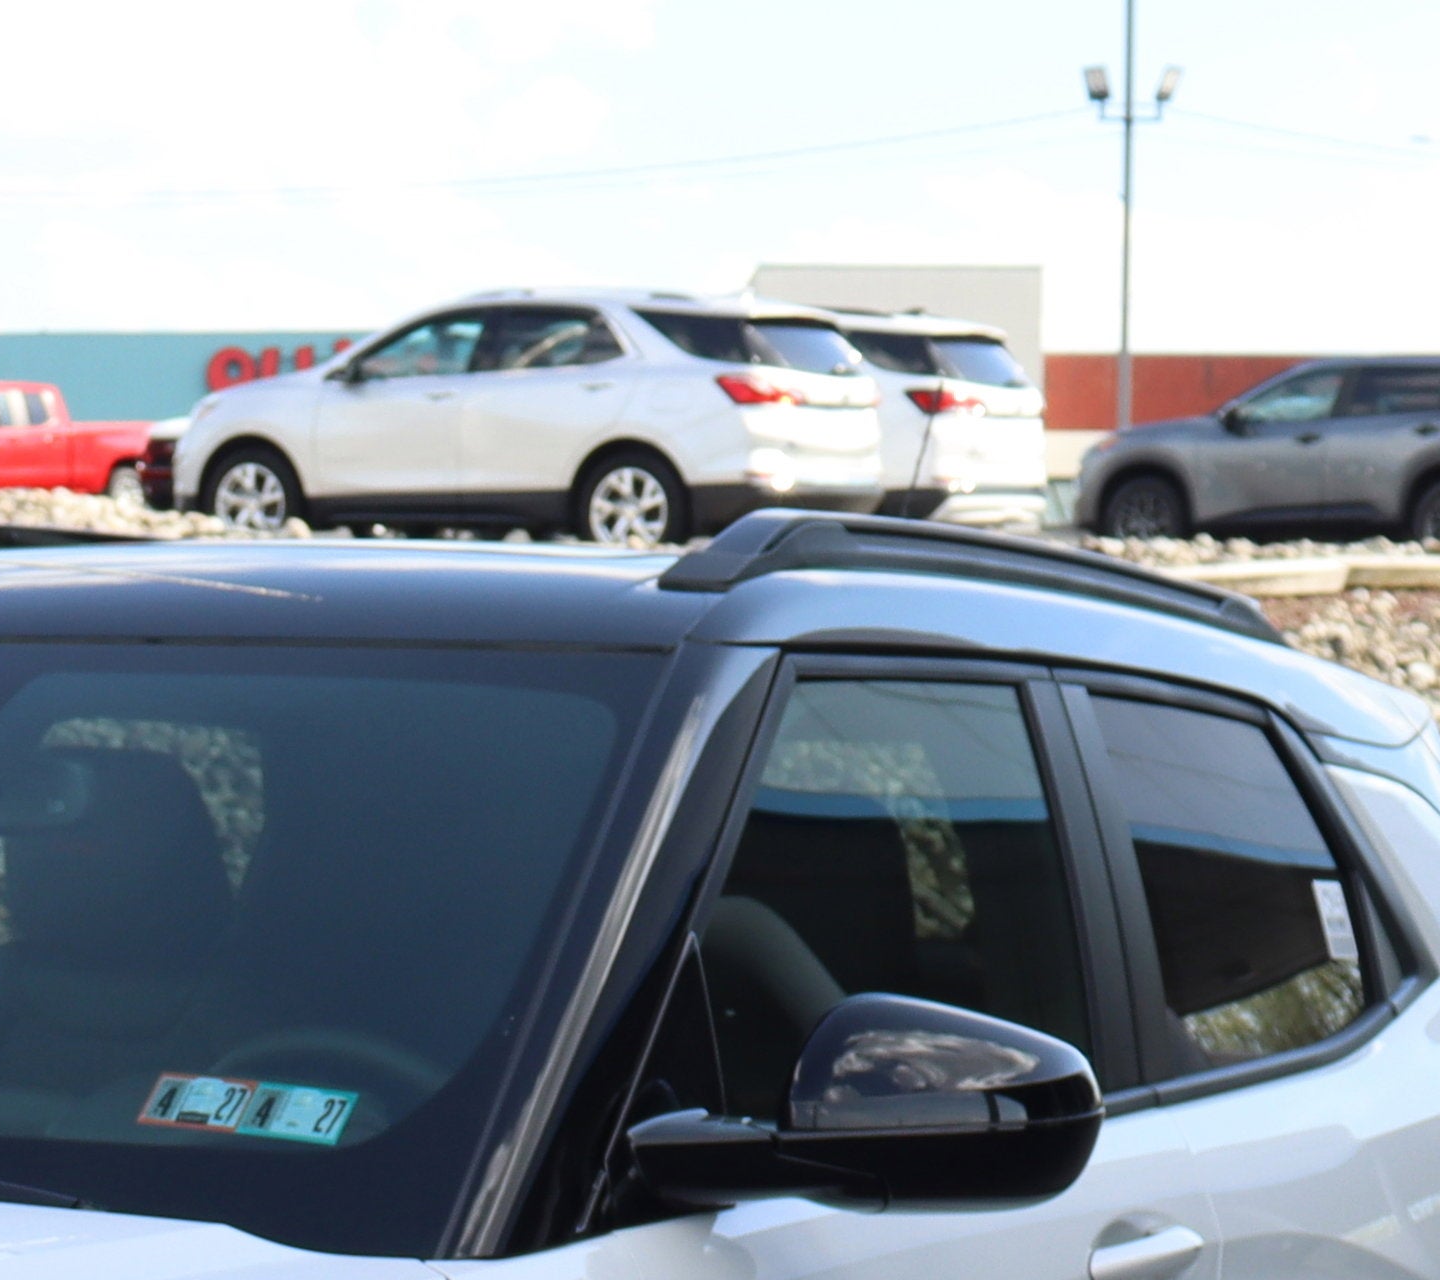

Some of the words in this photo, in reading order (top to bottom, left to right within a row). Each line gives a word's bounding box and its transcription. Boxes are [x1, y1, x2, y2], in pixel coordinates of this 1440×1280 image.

[153, 1087, 177, 1117] 4
[214, 1088, 247, 1124] 27
[251, 1097, 276, 1127] 4
[313, 1098, 347, 1136] 27
